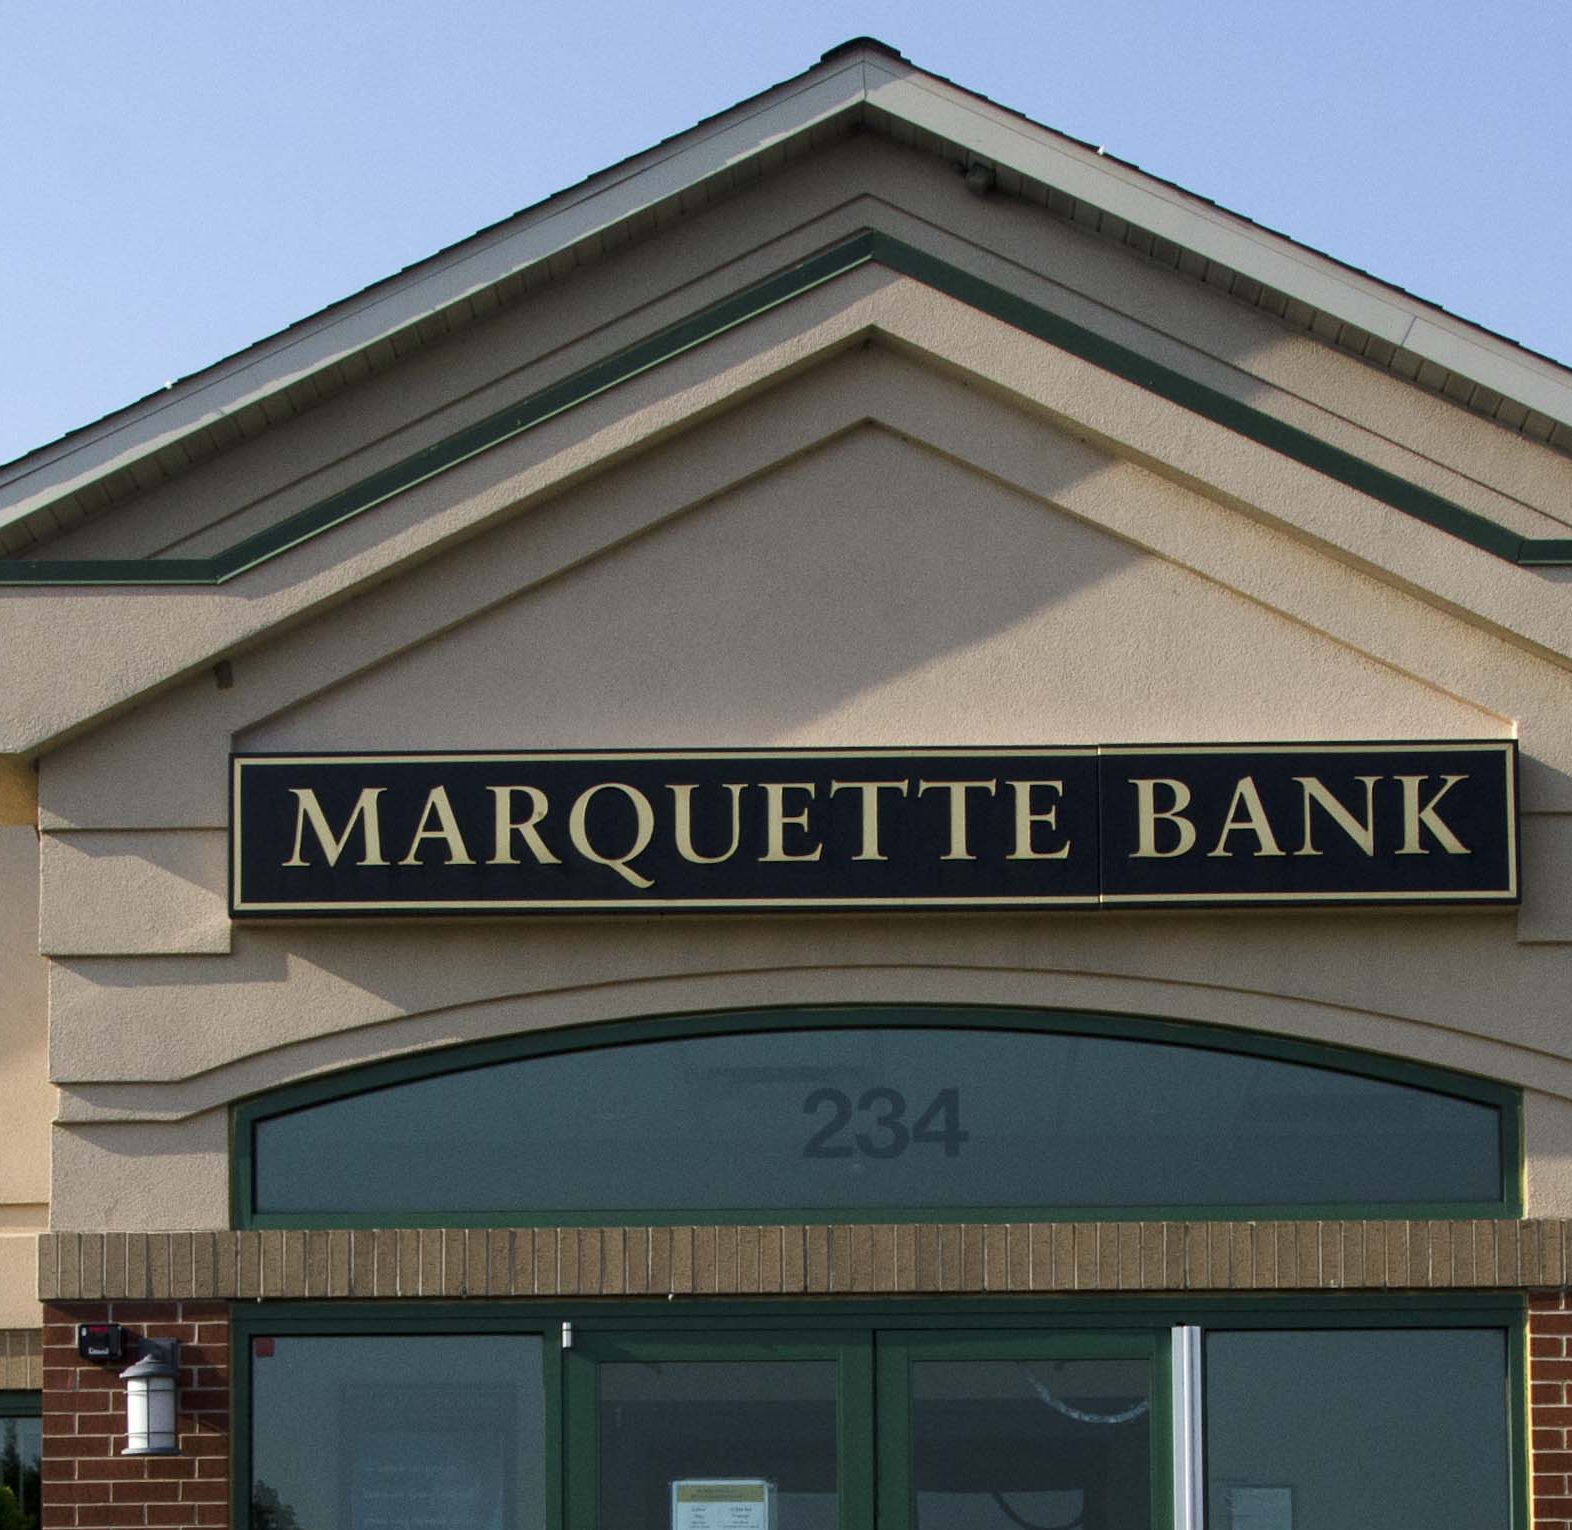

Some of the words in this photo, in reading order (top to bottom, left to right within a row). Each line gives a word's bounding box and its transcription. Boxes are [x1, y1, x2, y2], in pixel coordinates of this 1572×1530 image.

[281, 779, 1072, 888] MARQUETTE
[1126, 772, 1473, 860] BANK
[801, 1086, 970, 1161] 234
